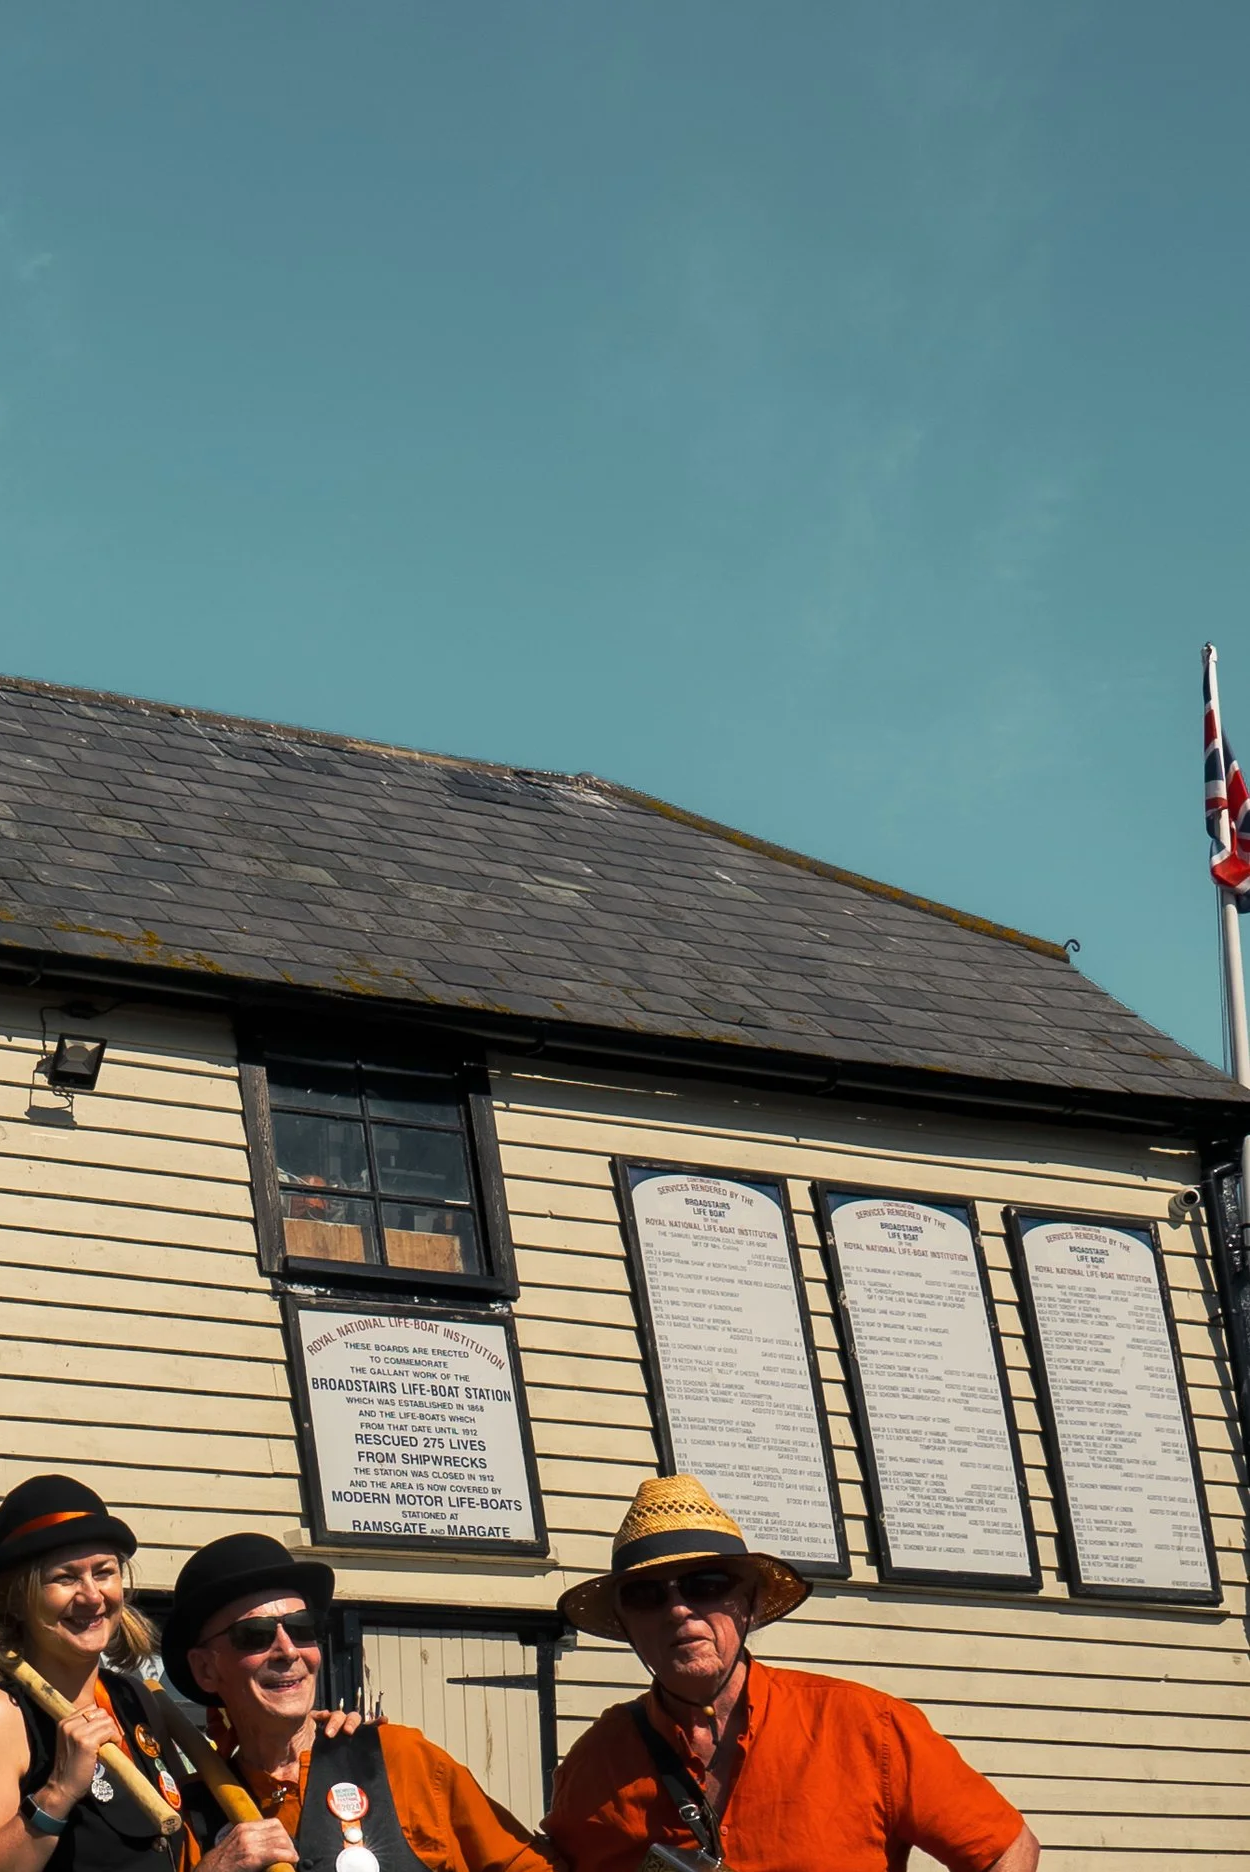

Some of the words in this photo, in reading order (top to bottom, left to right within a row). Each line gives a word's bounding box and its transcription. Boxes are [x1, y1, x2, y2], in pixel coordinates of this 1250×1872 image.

[657, 1184, 690, 1195] SERVICES
[691, 1184, 728, 1196] RENDERED
[730, 1191, 738, 1199] BY
[741, 1195, 754, 1207] THE
[685, 1198, 731, 1210] BROADSTAIRS
[693, 1208, 706, 1216] LIFE
[855, 1209, 885, 1219] SERVICES
[887, 1209, 921, 1220] RENDERED
[934, 1219, 946, 1230] THE
[645, 1218, 667, 1227] ROYAL
[669, 1221, 701, 1231] NATIONAL
[704, 1224, 735, 1235] LIFE-BOAT
[738, 1228, 778, 1239] INSTITUTION
[880, 1222, 923, 1233] BROADSTAIRS
[844, 1242, 864, 1250] ROYAL
[866, 1245, 896, 1254] NATIONAL
[931, 1251, 968, 1261] INSTITUTION
[1069, 1246, 1109, 1256] BROADSTAIRS
[1035, 1265, 1054, 1273] ROYAL
[1056, 1268, 1084, 1276] NATIONAL
[1117, 1274, 1151, 1284] INSTITUTION
[307, 1332, 337, 1356] ROYAL
[337, 1317, 385, 1338] NATIONAL
[389, 1317, 439, 1335] LIFE-BOAT
[443, 1327, 505, 1370] INSTITUTION
[344, 1342, 371, 1350] THESE
[375, 1344, 409, 1353] BOARDS
[412, 1347, 429, 1355] ARE
[431, 1348, 469, 1358] ERECTED
[384, 1357, 449, 1368] COMMEMORATE
[350, 1367, 367, 1375] THE
[370, 1368, 409, 1377] GALLANT
[412, 1371, 438, 1379] WORK
[454, 1374, 470, 1382] THE
[312, 1378, 397, 1394] BROADSTAIRS
[401, 1383, 459, 1398] LIFE-BOAT
[465, 1387, 511, 1402] STATION
[346, 1397, 374, 1405] WHICH
[399, 1400, 453, 1410] ESTABLISHED
[359, 1410, 376, 1418] AND
[379, 1411, 396, 1419] THE
[399, 1412, 446, 1422] LIFE-BOATS
[449, 1415, 475, 1424] WHICH
[387, 1424, 408, 1432] THAT
[411, 1425, 432, 1433] DATE
[435, 1426, 458, 1435] UNTIL
[462, 1428, 478, 1436] 1912
[355, 1434, 419, 1447] RESCUED
[423, 1438, 445, 1448] 275
[449, 1439, 486, 1451] LIVES
[358, 1451, 397, 1465] FROM
[401, 1454, 487, 1469] SHIPWRECKS
[354, 1467, 371, 1476] THE
[373, 1468, 408, 1477] STATION
[411, 1470, 429, 1478] WAS
[432, 1472, 465, 1481] CLOSED
[478, 1474, 494, 1482] 1912
[350, 1480, 367, 1488] AND
[370, 1481, 388, 1489] THE
[390, 1482, 414, 1491] AREA
[427, 1484, 447, 1492] NOW
[450, 1485, 488, 1495] COVERED
[332, 1491, 390, 1504] MODERN
[395, 1494, 444, 1507] MOTOR
[449, 1498, 522, 1511] LIFE-BOATS
[402, 1511, 446, 1520] STATIONED
[450, 1513, 458, 1521] AT
[352, 1520, 427, 1534] RAMSGATE
[430, 1527, 445, 1535] AND
[447, 1525, 511, 1538] MARGATE
